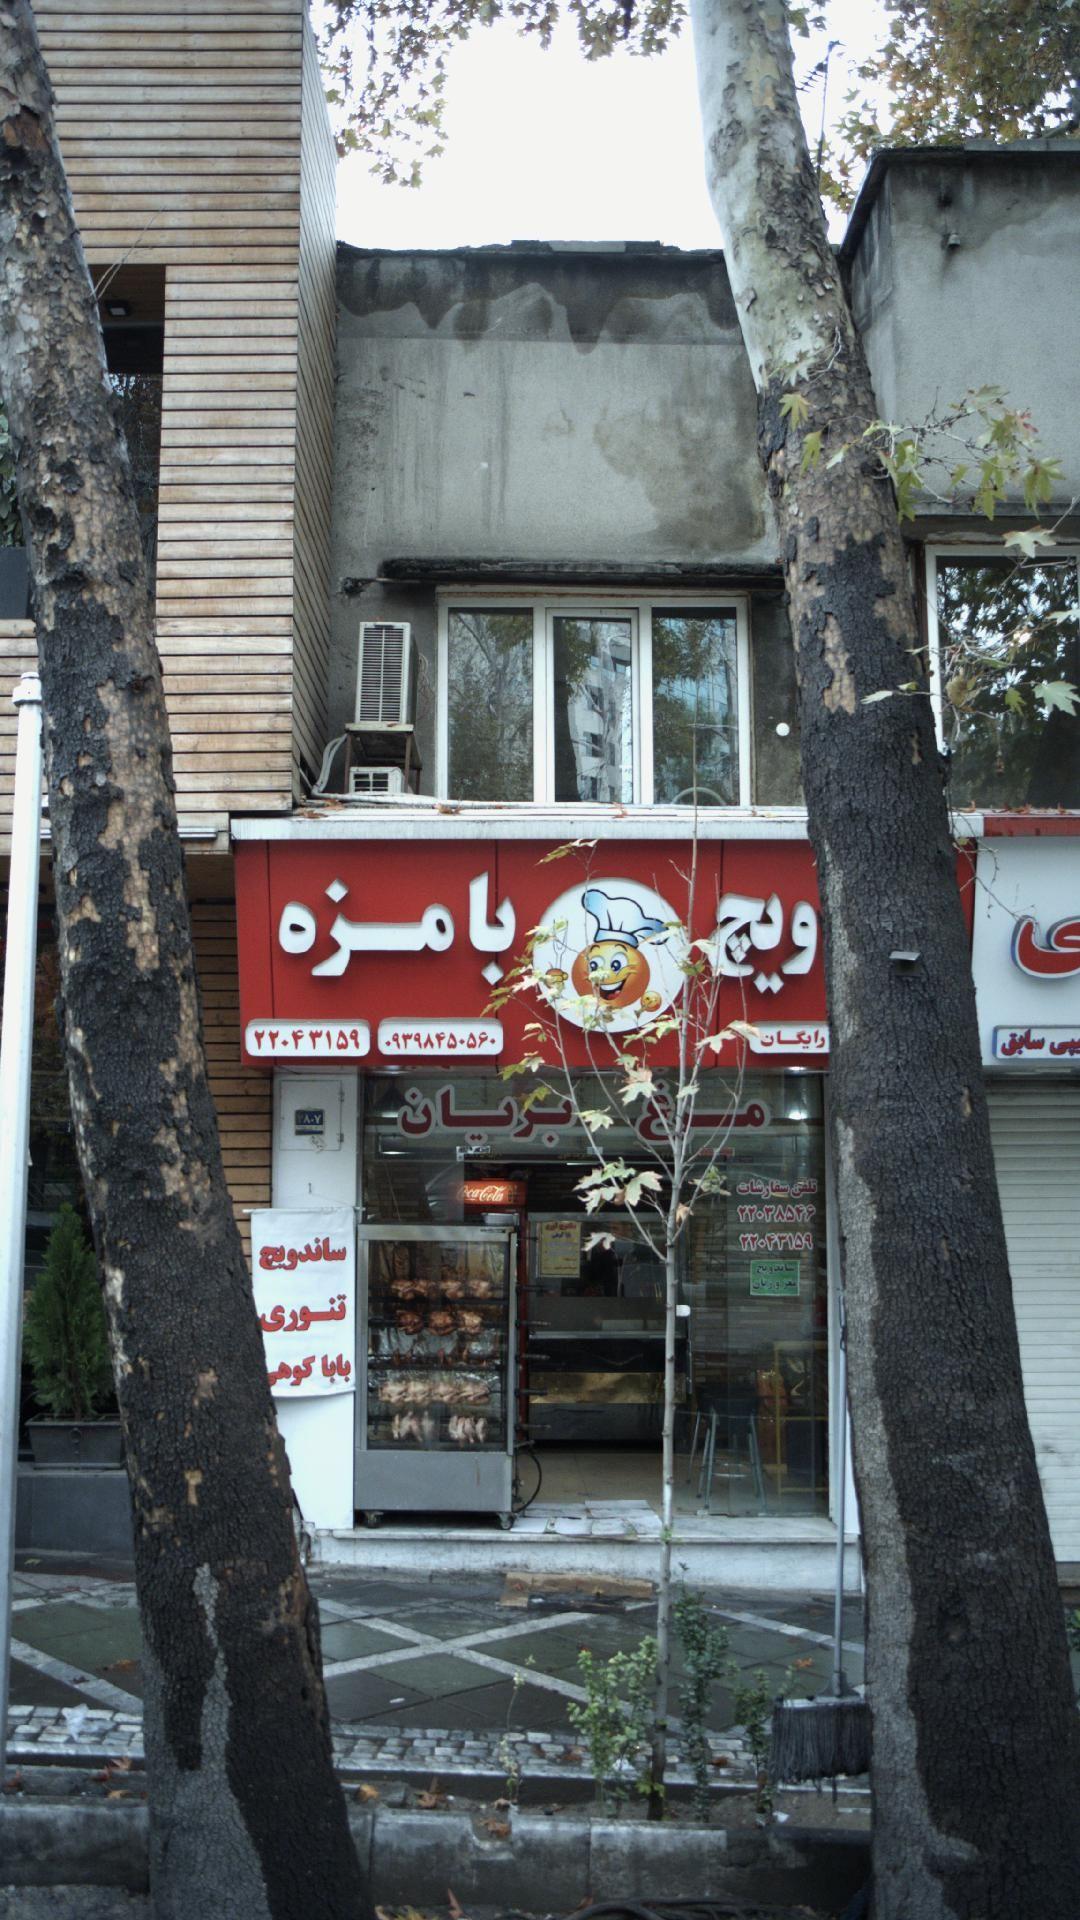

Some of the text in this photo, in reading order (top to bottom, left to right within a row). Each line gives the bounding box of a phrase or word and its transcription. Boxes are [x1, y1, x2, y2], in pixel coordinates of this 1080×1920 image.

[254, 1029, 360, 1051] ۲۲۰۴۳۱۵۹
[385, 1031, 496, 1050] ۰۹۳۹۸۴۵۰۵۶۰
[760, 1029, 826, 1049] رایگان
[1001, 1029, 1045, 1056] سابق
[398, 1079, 769, 1147] مرغ بریان
[736, 1178, 818, 1198] تلفن سفارشات
[737, 1204, 816, 1223] ۲۲۰۳۸۵۴۶
[739, 1232, 814, 1251] ۲۲۰۴۳۱۵۹
[259, 1236, 347, 1270] ساندویچ
[259, 1294, 347, 1332] تنوری
[321, 1353, 352, 1383] بابا
